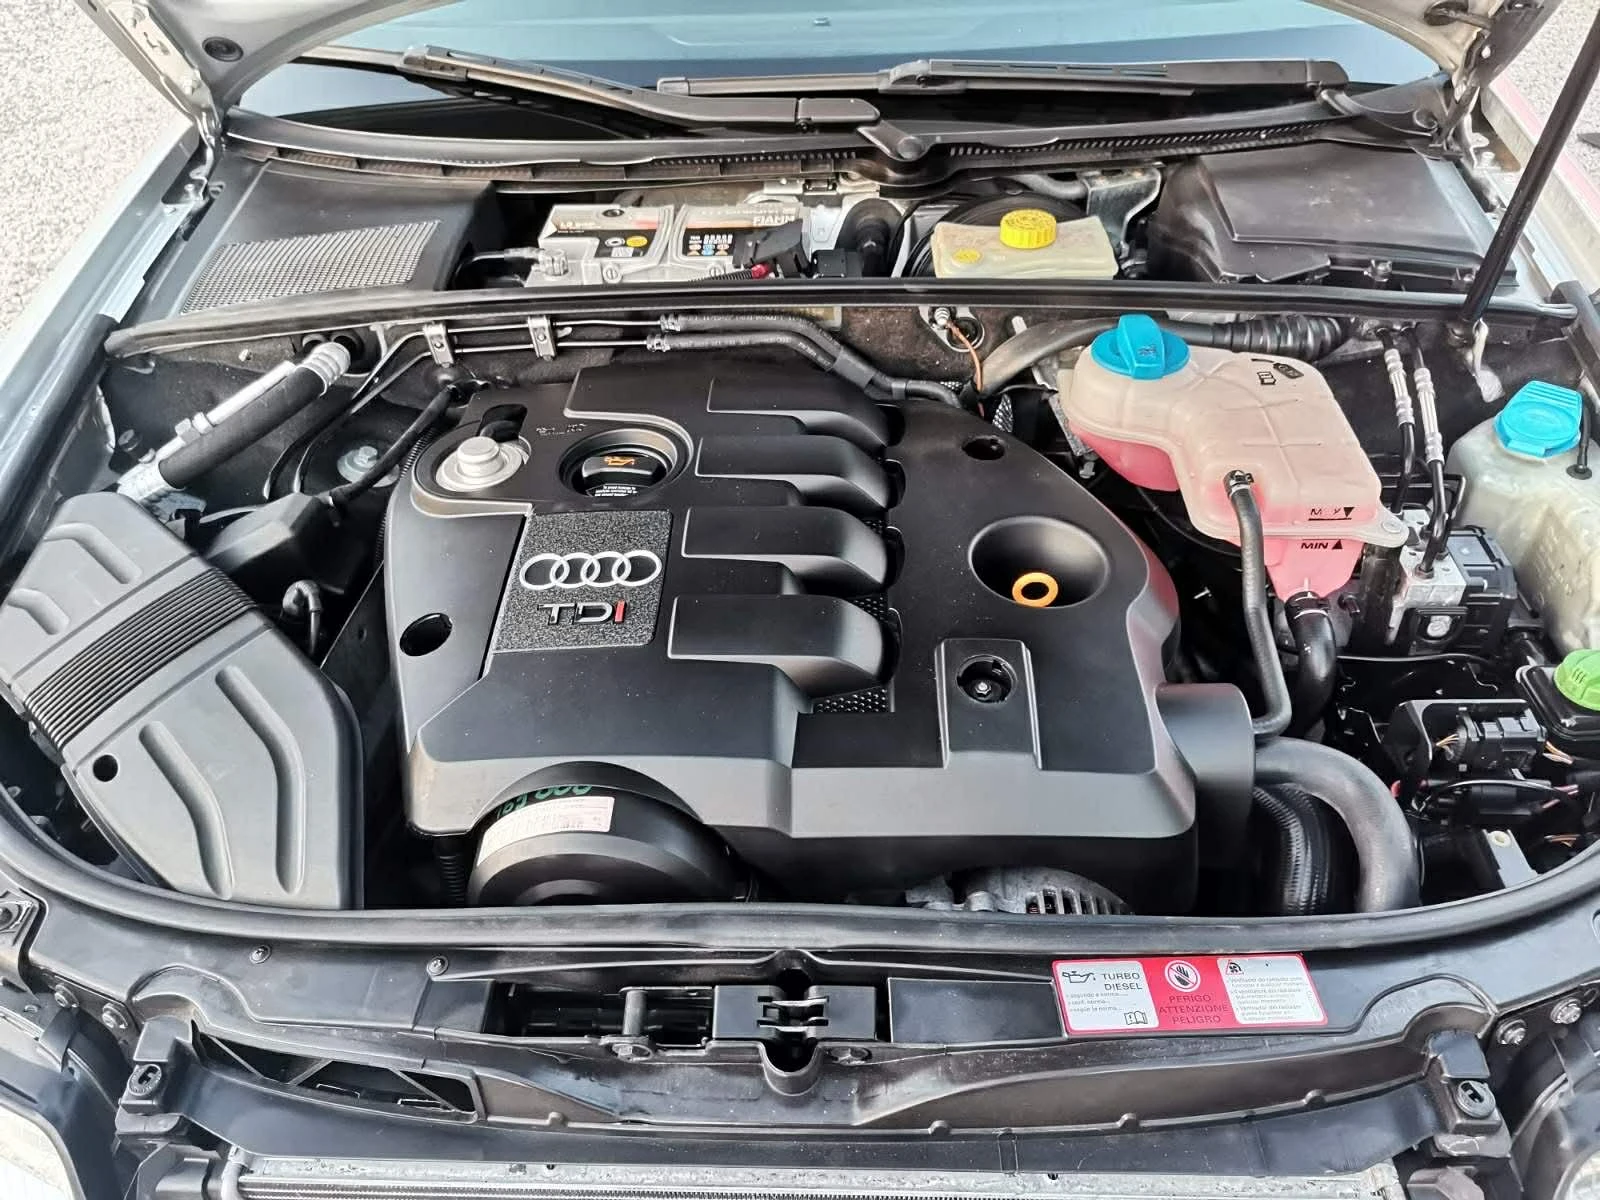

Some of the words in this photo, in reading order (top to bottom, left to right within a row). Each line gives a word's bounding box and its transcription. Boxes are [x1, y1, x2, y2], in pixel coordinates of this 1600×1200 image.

[537, 600, 626, 624] TDI
[1102, 972, 1140, 981] TURBO
[1104, 982, 1143, 991] DIESEL
[1168, 994, 1212, 1003] PERIGO
[1159, 1004, 1230, 1014] ATTENZIONE
[1172, 1015, 1221, 1025] PELIGRO
